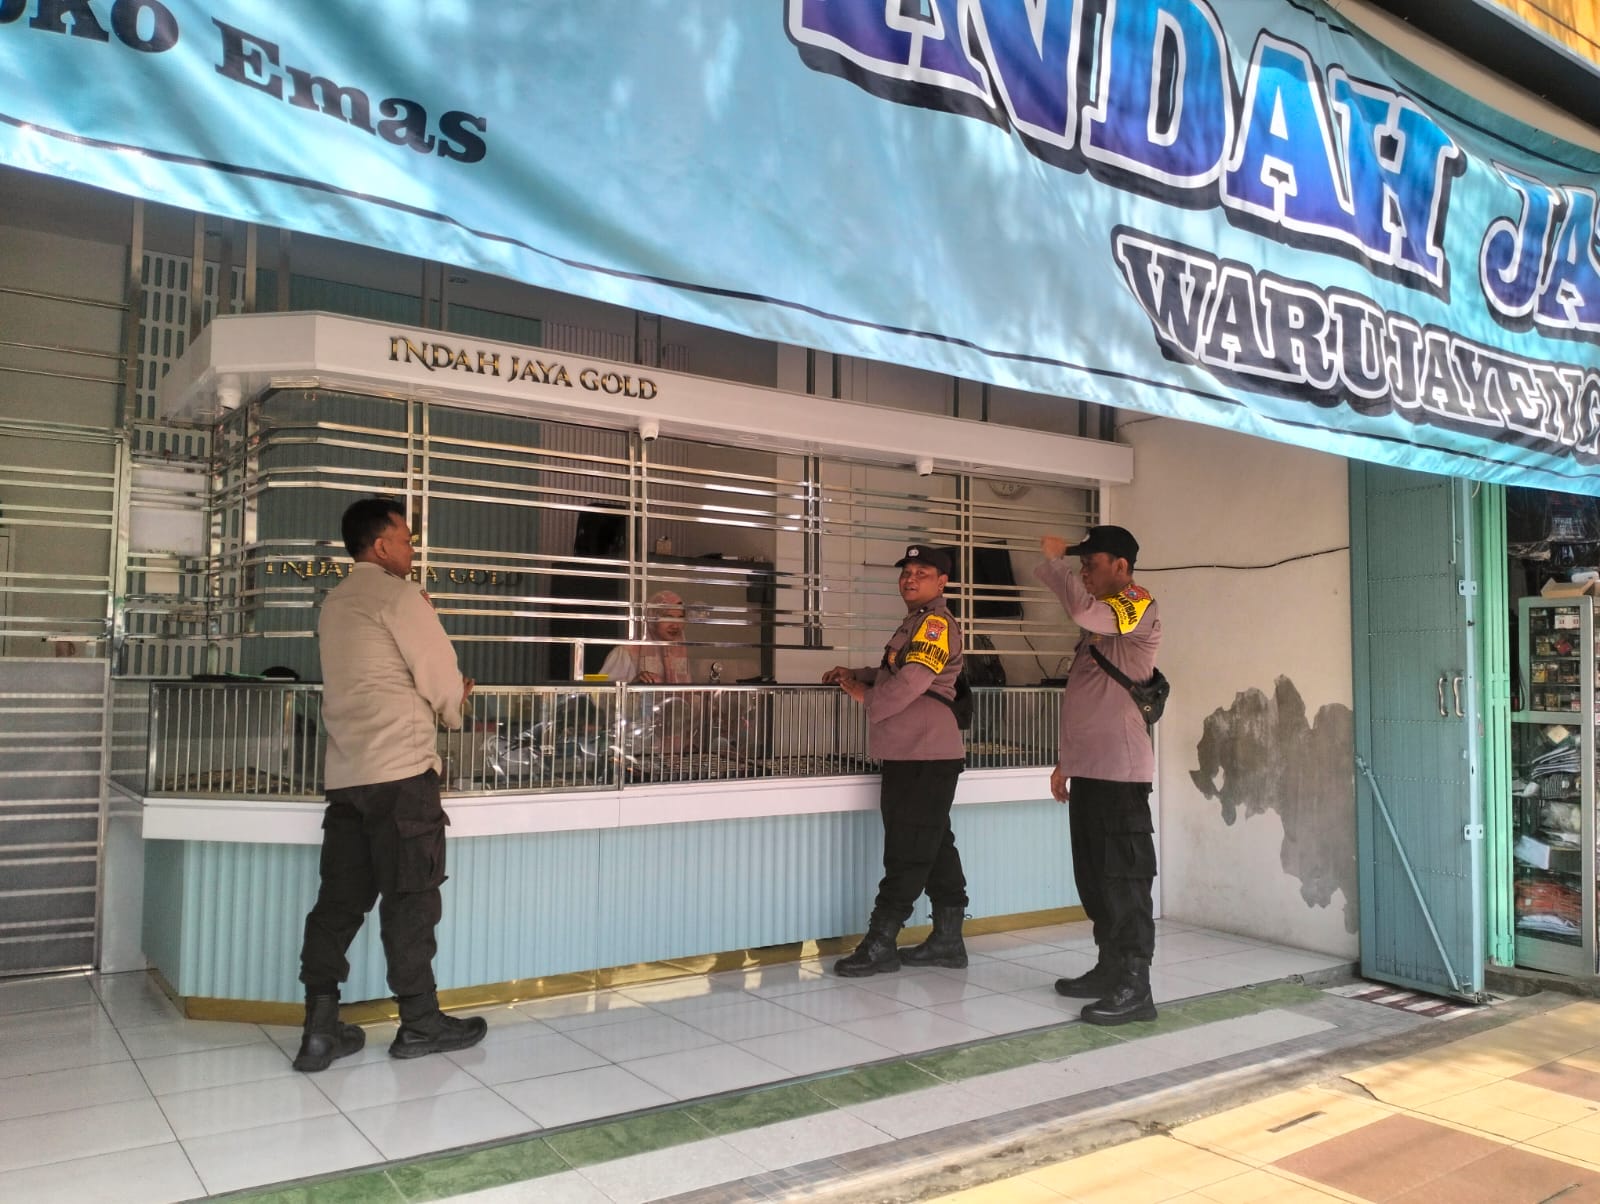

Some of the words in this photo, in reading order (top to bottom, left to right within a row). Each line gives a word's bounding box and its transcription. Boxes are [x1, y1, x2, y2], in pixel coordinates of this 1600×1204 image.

[211, 16, 487, 164] Emas
[1480, 160, 1600, 336] JA
[388, 336, 500, 377] INDAH
[507, 355, 573, 388] JAYA
[579, 367, 658, 400] GOLD
